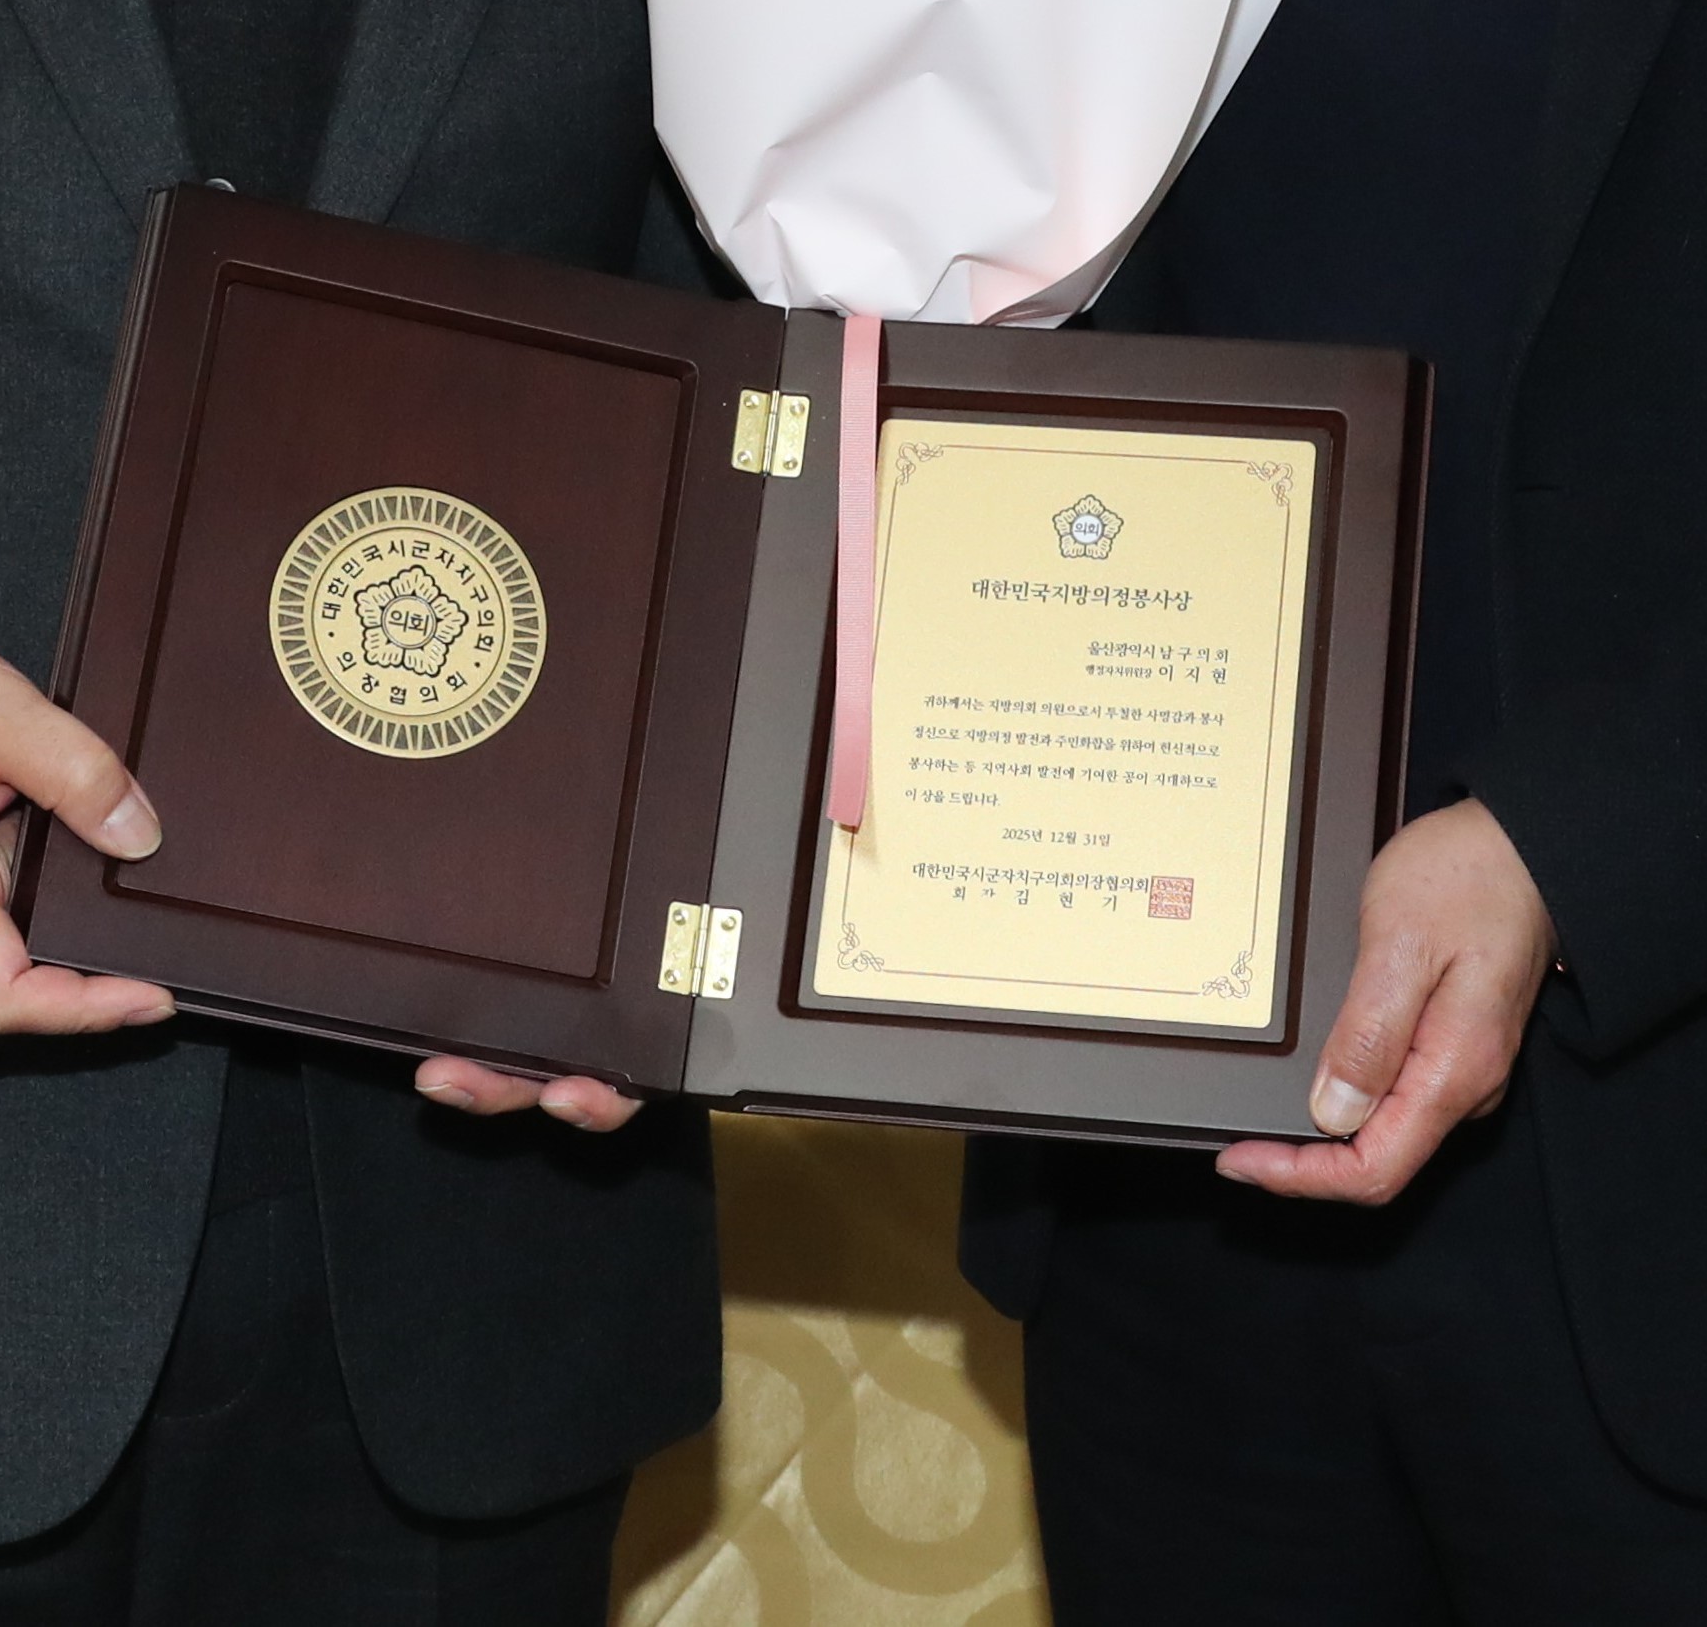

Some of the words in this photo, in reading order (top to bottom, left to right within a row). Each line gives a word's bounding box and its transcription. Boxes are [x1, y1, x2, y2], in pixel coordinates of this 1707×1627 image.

[1074, 522, 1100, 536] 의회
[971, 578, 1193, 612] 대한민국지방의정봉사상
[389, 609, 430, 636] 의회
[1087, 640, 1156, 660] 울산광역시
[923, 694, 985, 712] 귀하께서는
[989, 698, 1037, 715] 지방의회
[1040, 702, 1102, 718] 의원으로서
[1105, 707, 1142, 722] 투철한
[1146, 709, 1197, 725] 사명감과
[1199, 712, 1225, 726] 봉사
[913, 725, 961, 740] 정신으로
[964, 729, 1012, 744] 지방의정
[1015, 732, 1052, 747] 발전과
[1055, 735, 1116, 751] 주민화합을
[1119, 738, 1156, 754] 위하여
[1160, 741, 1221, 757] 헌신적으로
[908, 756, 960, 773] 봉사하는
[964, 761, 976, 774] 등
[982, 762, 1032, 778] 지역사회
[1037, 765, 1076, 781] 발전에
[1081, 768, 1118, 783] 기여한
[1122, 770, 1149, 785] 공이
[1154, 772, 1218, 789] 지대하므로
[905, 788, 917, 801] 이
[920, 789, 945, 804] 상을
[948, 792, 1001, 807] 드립니다.
[1002, 828, 1043, 842] 2025년
[1050, 831, 1077, 846] 12월
[1083, 833, 1111, 847] 31일
[912, 862, 1149, 894] 대한민국시군자치구의회의장협의회
